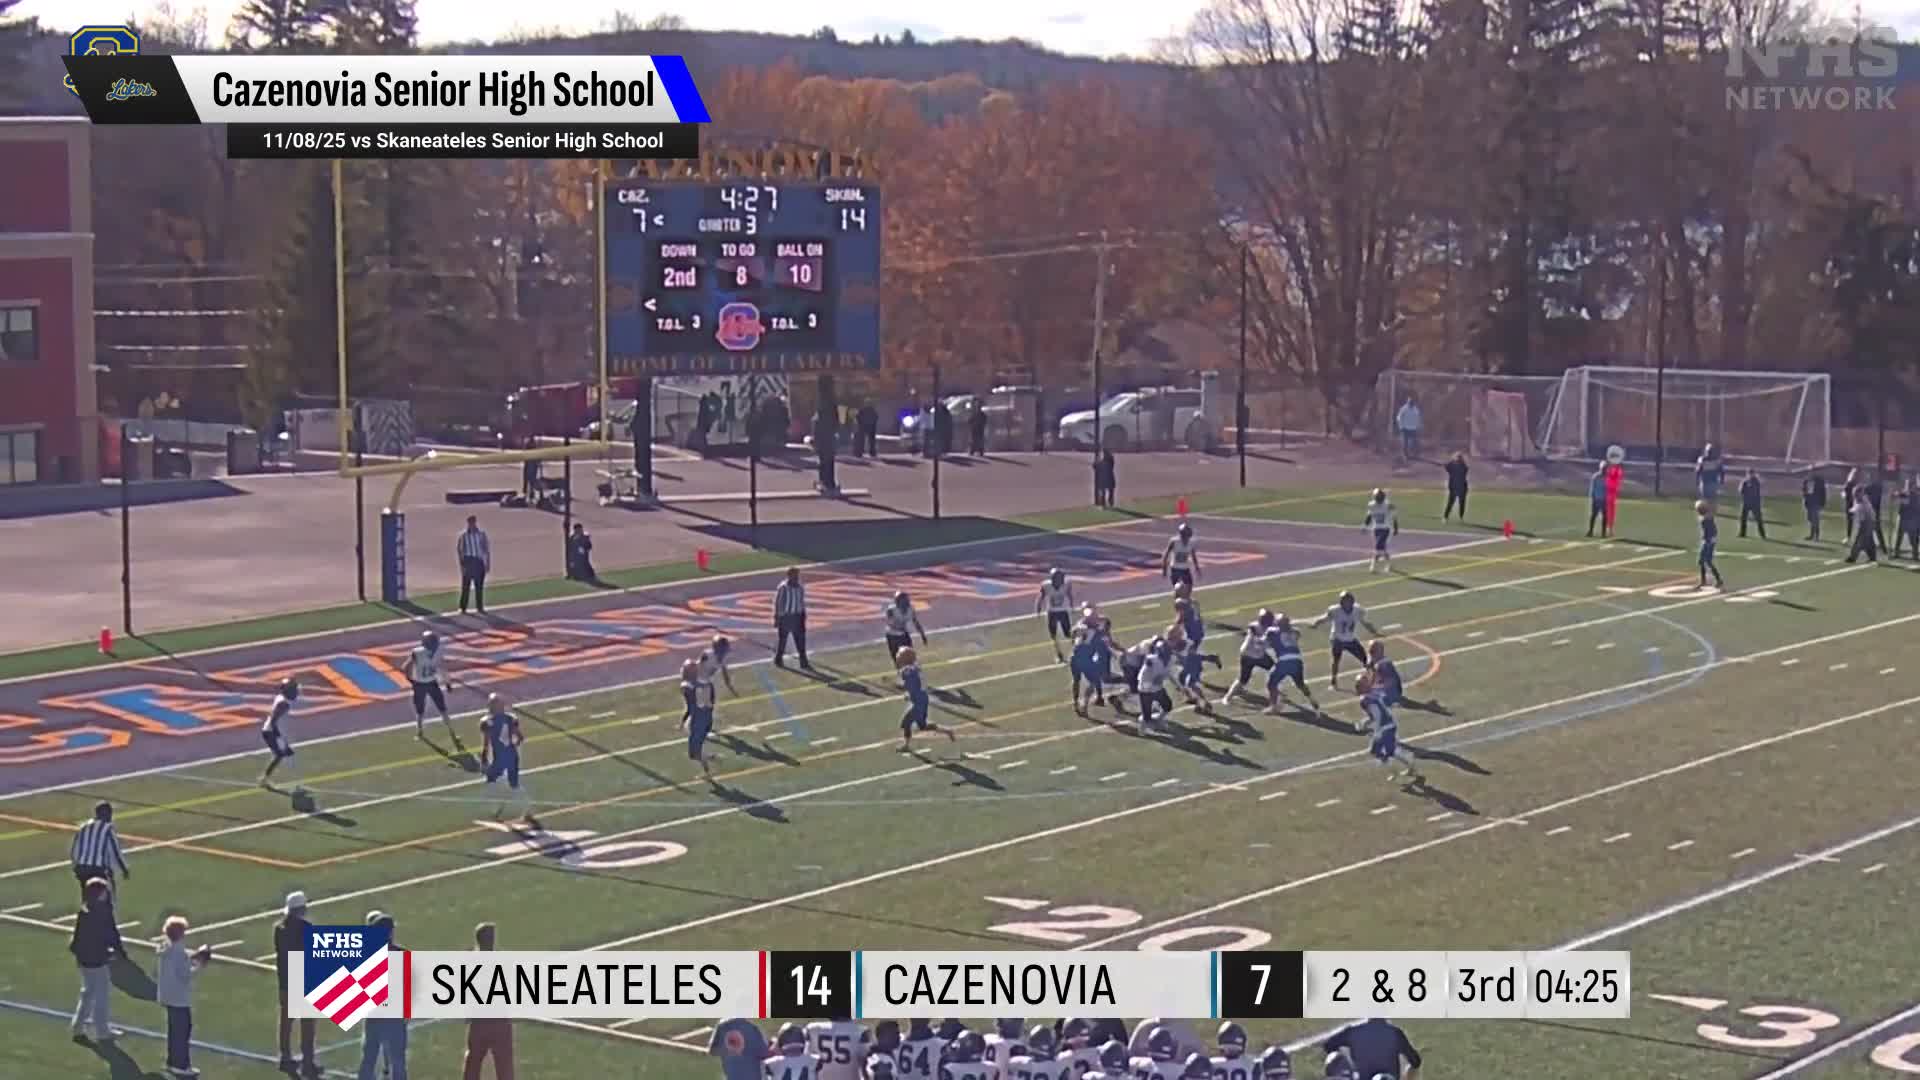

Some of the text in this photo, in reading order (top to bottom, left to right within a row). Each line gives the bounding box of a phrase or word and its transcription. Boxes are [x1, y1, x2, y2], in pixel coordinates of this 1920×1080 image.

[721, 187, 778, 212] 4:27
[633, 208, 647, 233] 7
[746, 214, 757, 235] 3
[841, 208, 866, 231] 14
[661, 244, 697, 257] DOWN
[722, 244, 737, 257] TO
[664, 267, 697, 288] 2nd
[736, 266, 748, 285] 8
[790, 264, 811, 284] 10
[692, 316, 701, 329] 3
[808, 314, 817, 328] 3
[613, 351, 865, 372] HOME OF THE LAKERS
[985, 904, 1273, 952] 20
[819, 1035, 851, 1065] 55
[900, 1043, 930, 1076] 64
